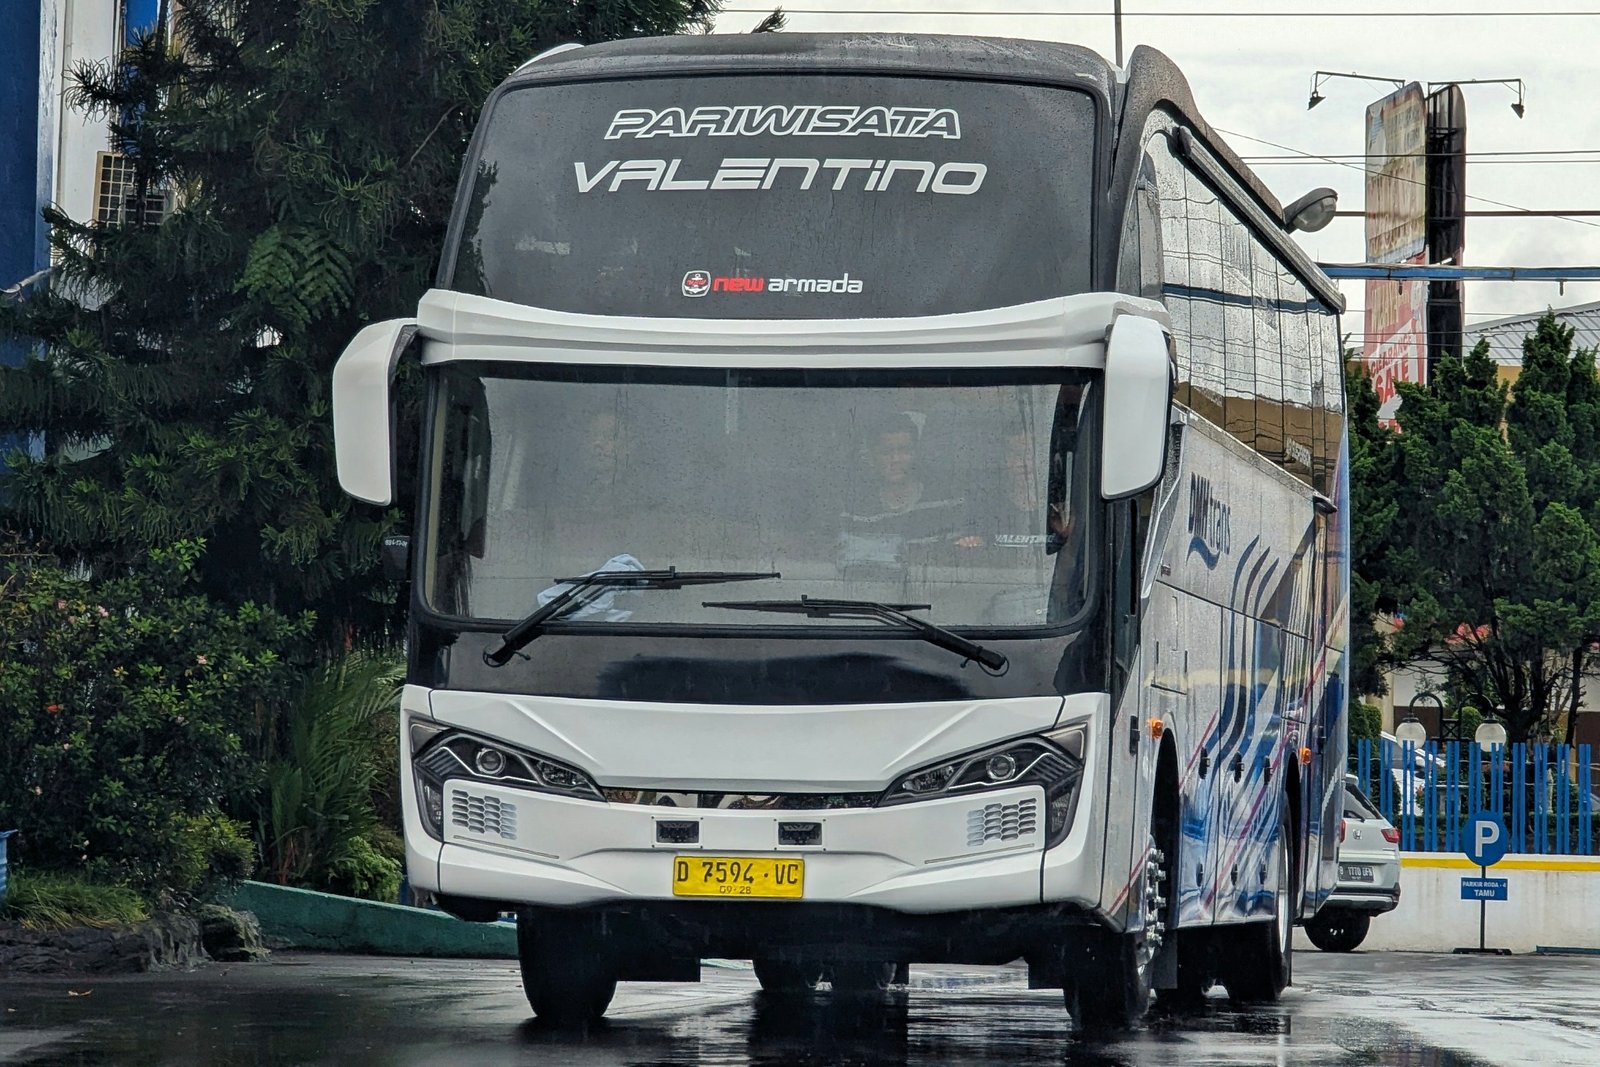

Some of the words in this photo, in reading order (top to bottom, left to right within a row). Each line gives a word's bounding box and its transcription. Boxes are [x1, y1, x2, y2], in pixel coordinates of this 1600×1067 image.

[604, 105, 961, 139] PARIWISATA
[712, 277, 764, 293] new
[768, 273, 863, 294] armada
[1475, 820, 1500, 857] P
[677, 861, 689, 882] D
[702, 861, 754, 883] 7594
[775, 863, 799, 885] VC
[1474, 889, 1495, 897] TAMU
